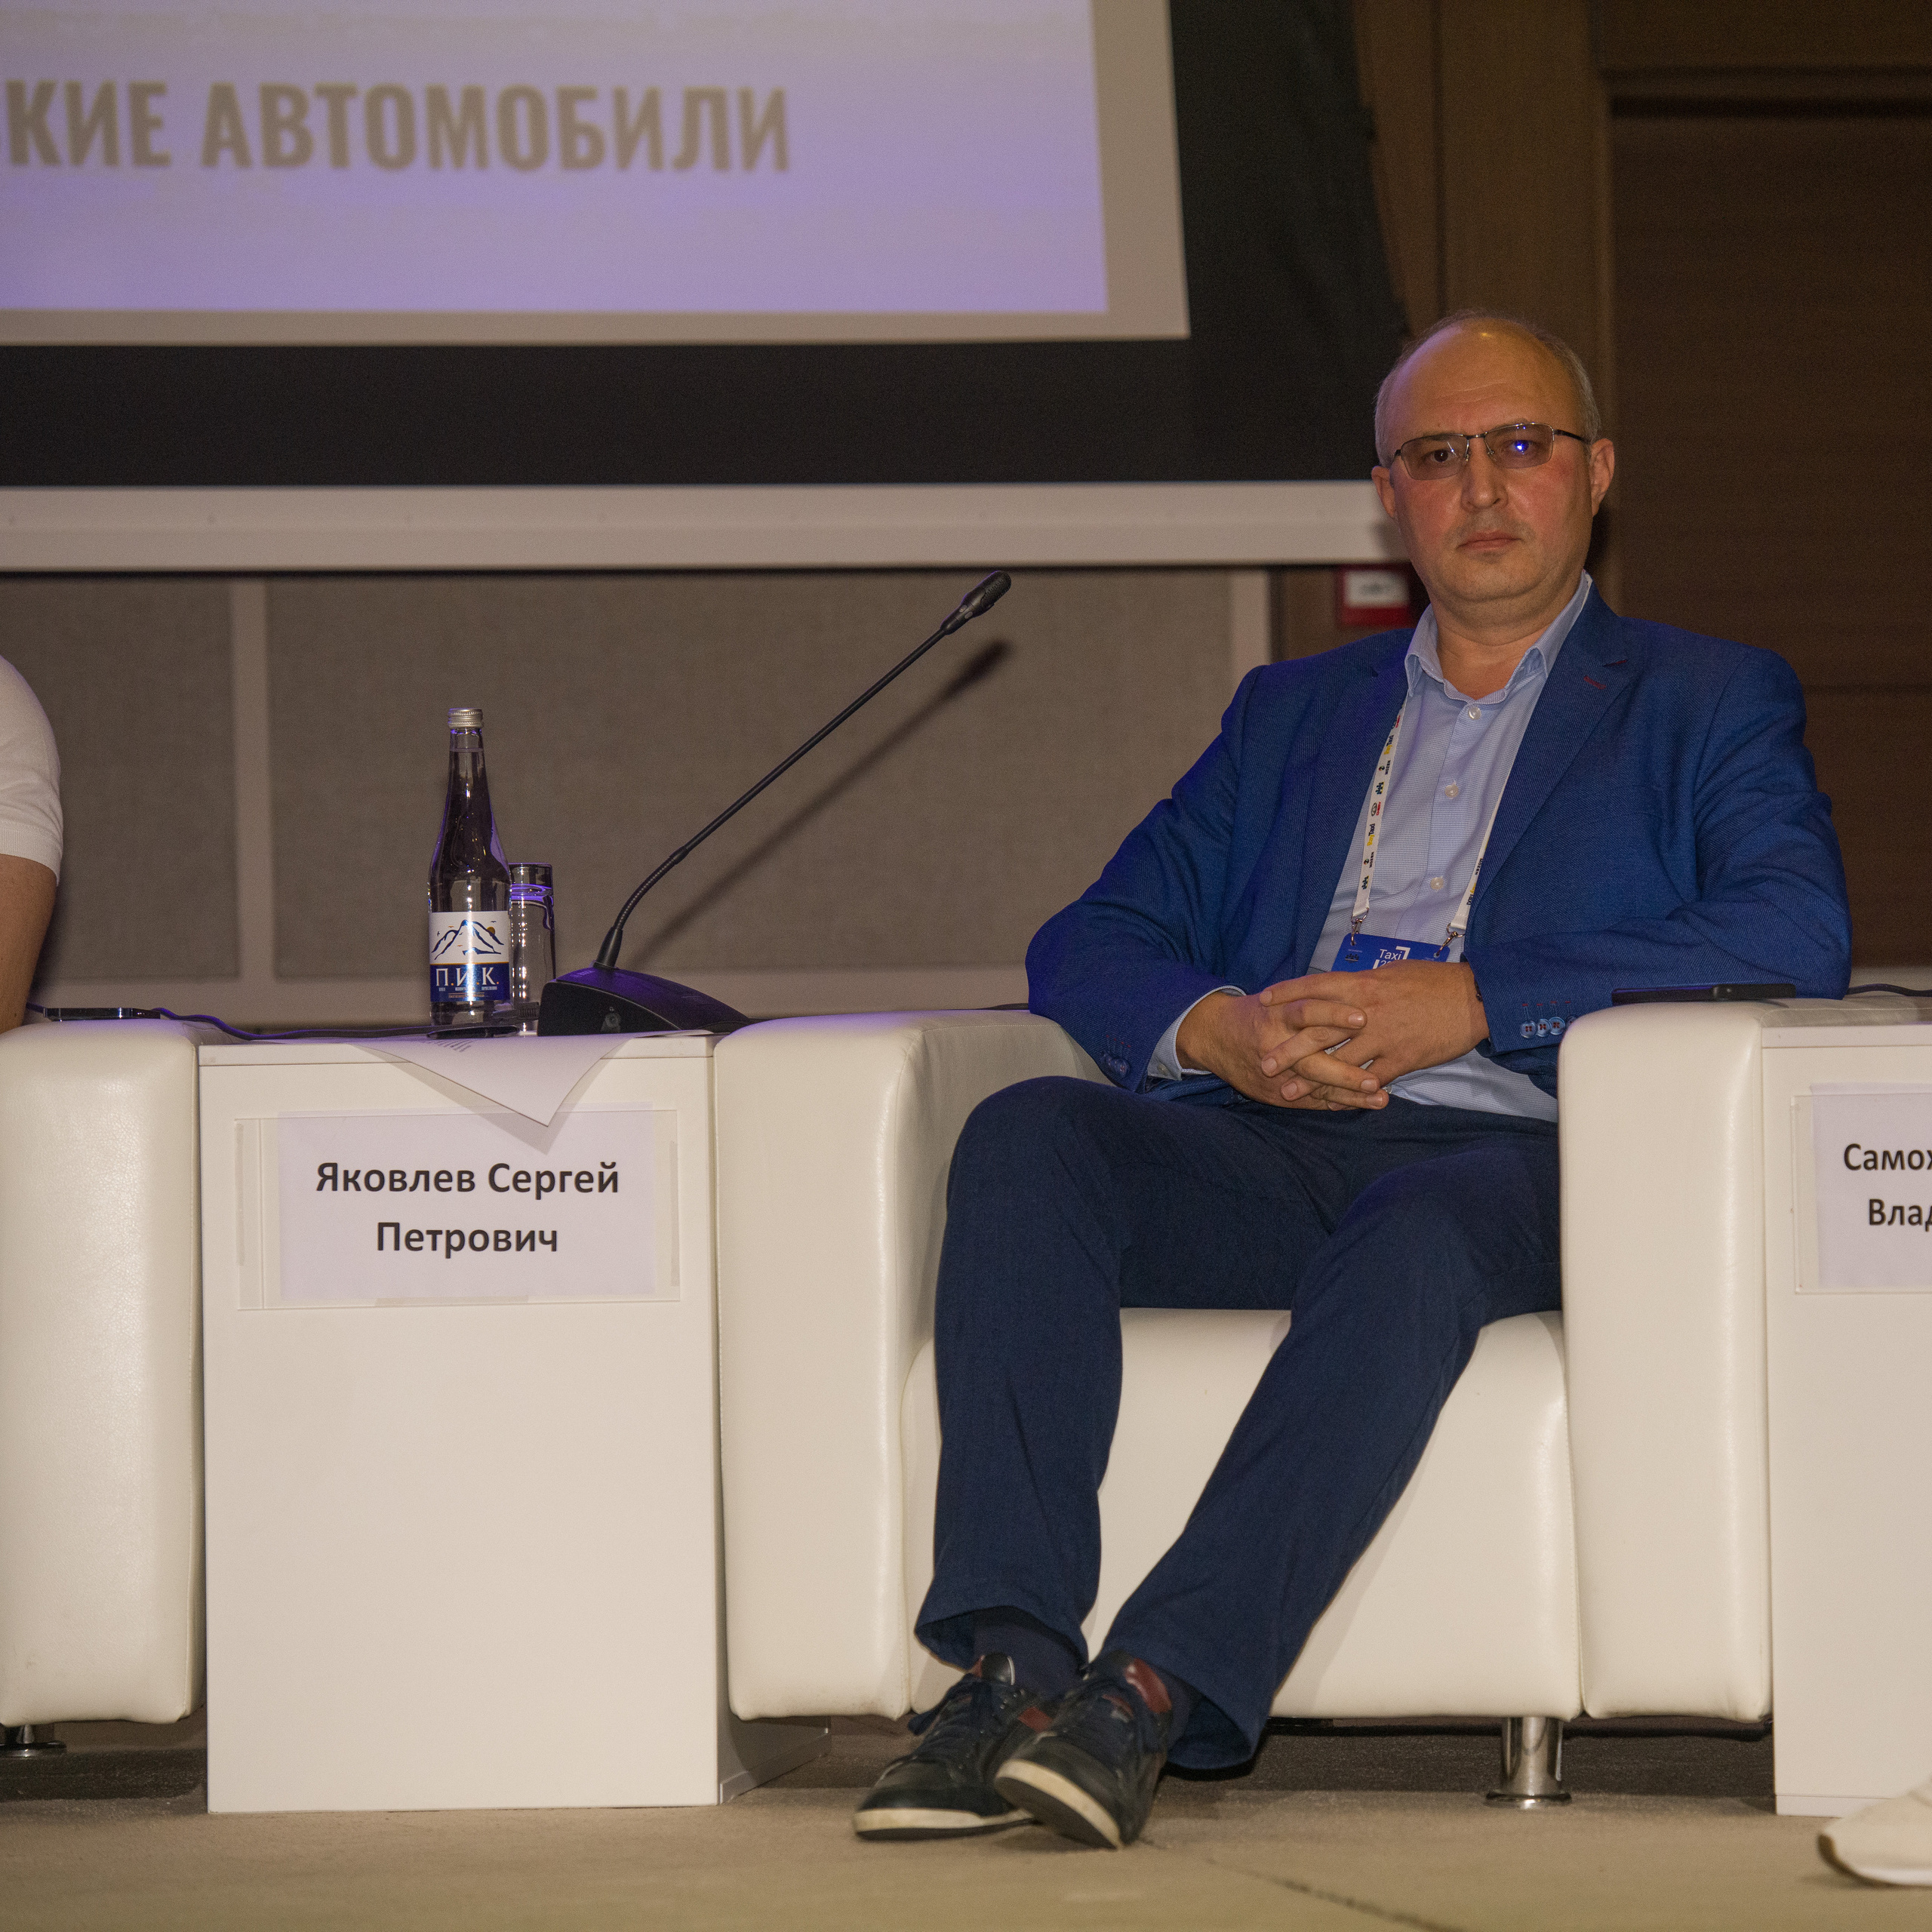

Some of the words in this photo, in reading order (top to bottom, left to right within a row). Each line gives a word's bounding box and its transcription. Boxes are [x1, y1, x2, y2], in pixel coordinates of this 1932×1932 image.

[5, 78, 172, 167] КИЕ
[199, 81, 789, 172] АВТОМОБИЛИ
[1379, 949, 1403, 961] Taxi
[316, 1162, 475, 1192] Яковлев
[488, 1161, 619, 1201] Сергей
[377, 1222, 558, 1260] Петрович
